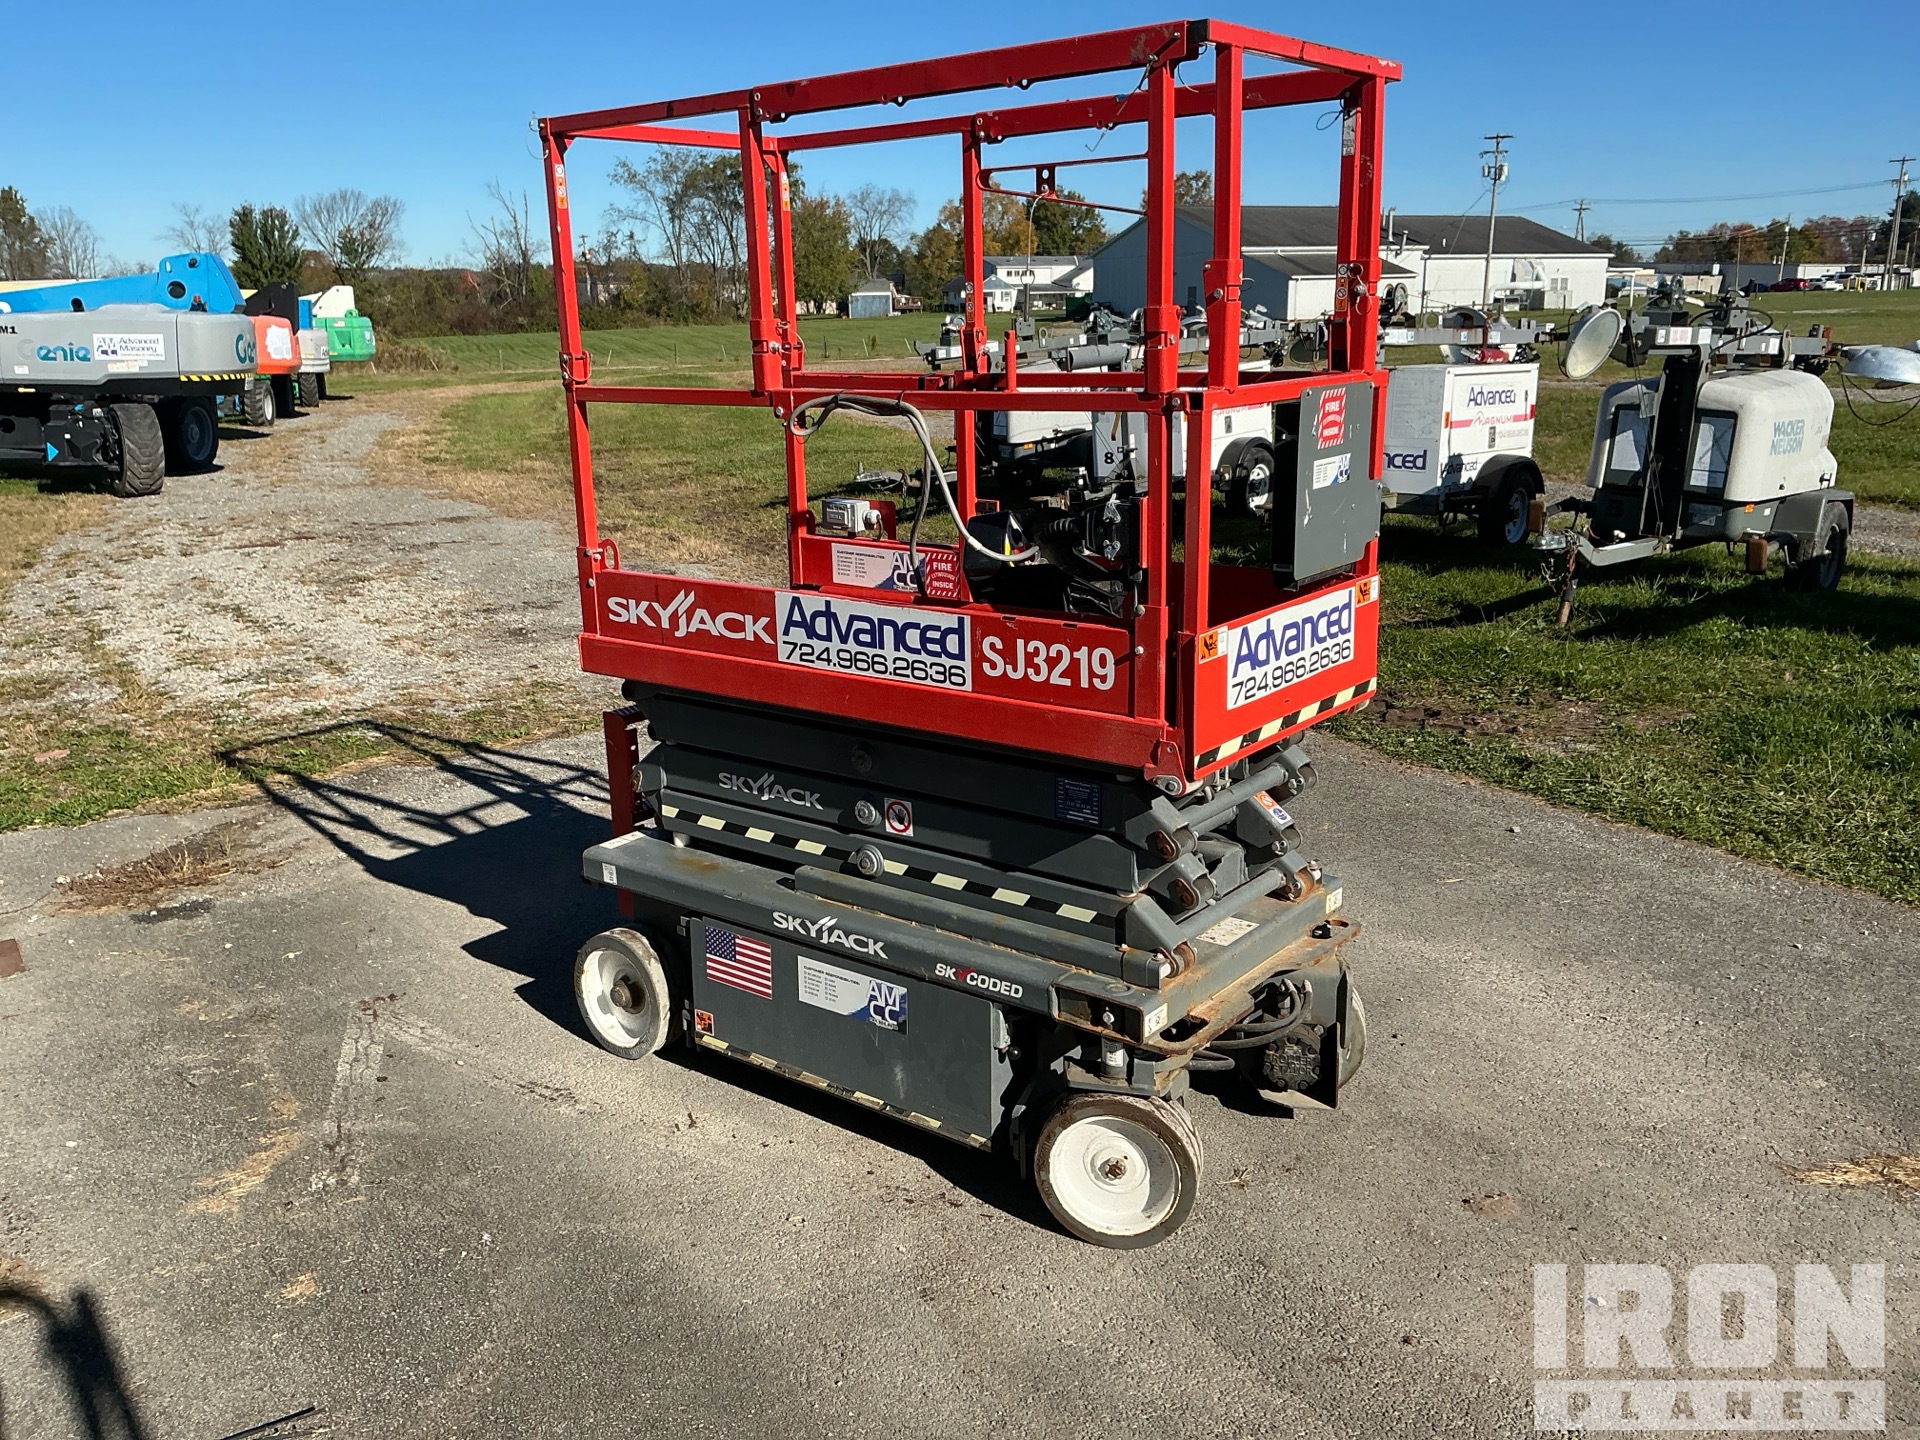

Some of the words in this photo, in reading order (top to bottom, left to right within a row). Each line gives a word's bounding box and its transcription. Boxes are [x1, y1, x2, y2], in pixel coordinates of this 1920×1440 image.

[119, 337, 159, 345] Advanced
[120, 345, 157, 353] Masonry
[1467, 386, 1516, 407] Advanced
[1770, 435, 1804, 456] NEUSON
[1773, 419, 1805, 438] WACKER
[1104, 452, 1114, 465] 8
[932, 561, 953, 572] FIRE
[932, 580, 954, 589] INSIDE
[607, 588, 776, 645] SKYJACK
[782, 595, 966, 662] Advanced
[1232, 589, 1353, 678] Advanced
[782, 640, 967, 687] 724.966.2636
[982, 635, 1115, 690] SJ3219
[1231, 638, 1351, 706] 724.966.2636
[718, 772, 824, 810] SKYJACK
[772, 911, 889, 959] SKYJACK
[934, 963, 1023, 998] SKYCODED
